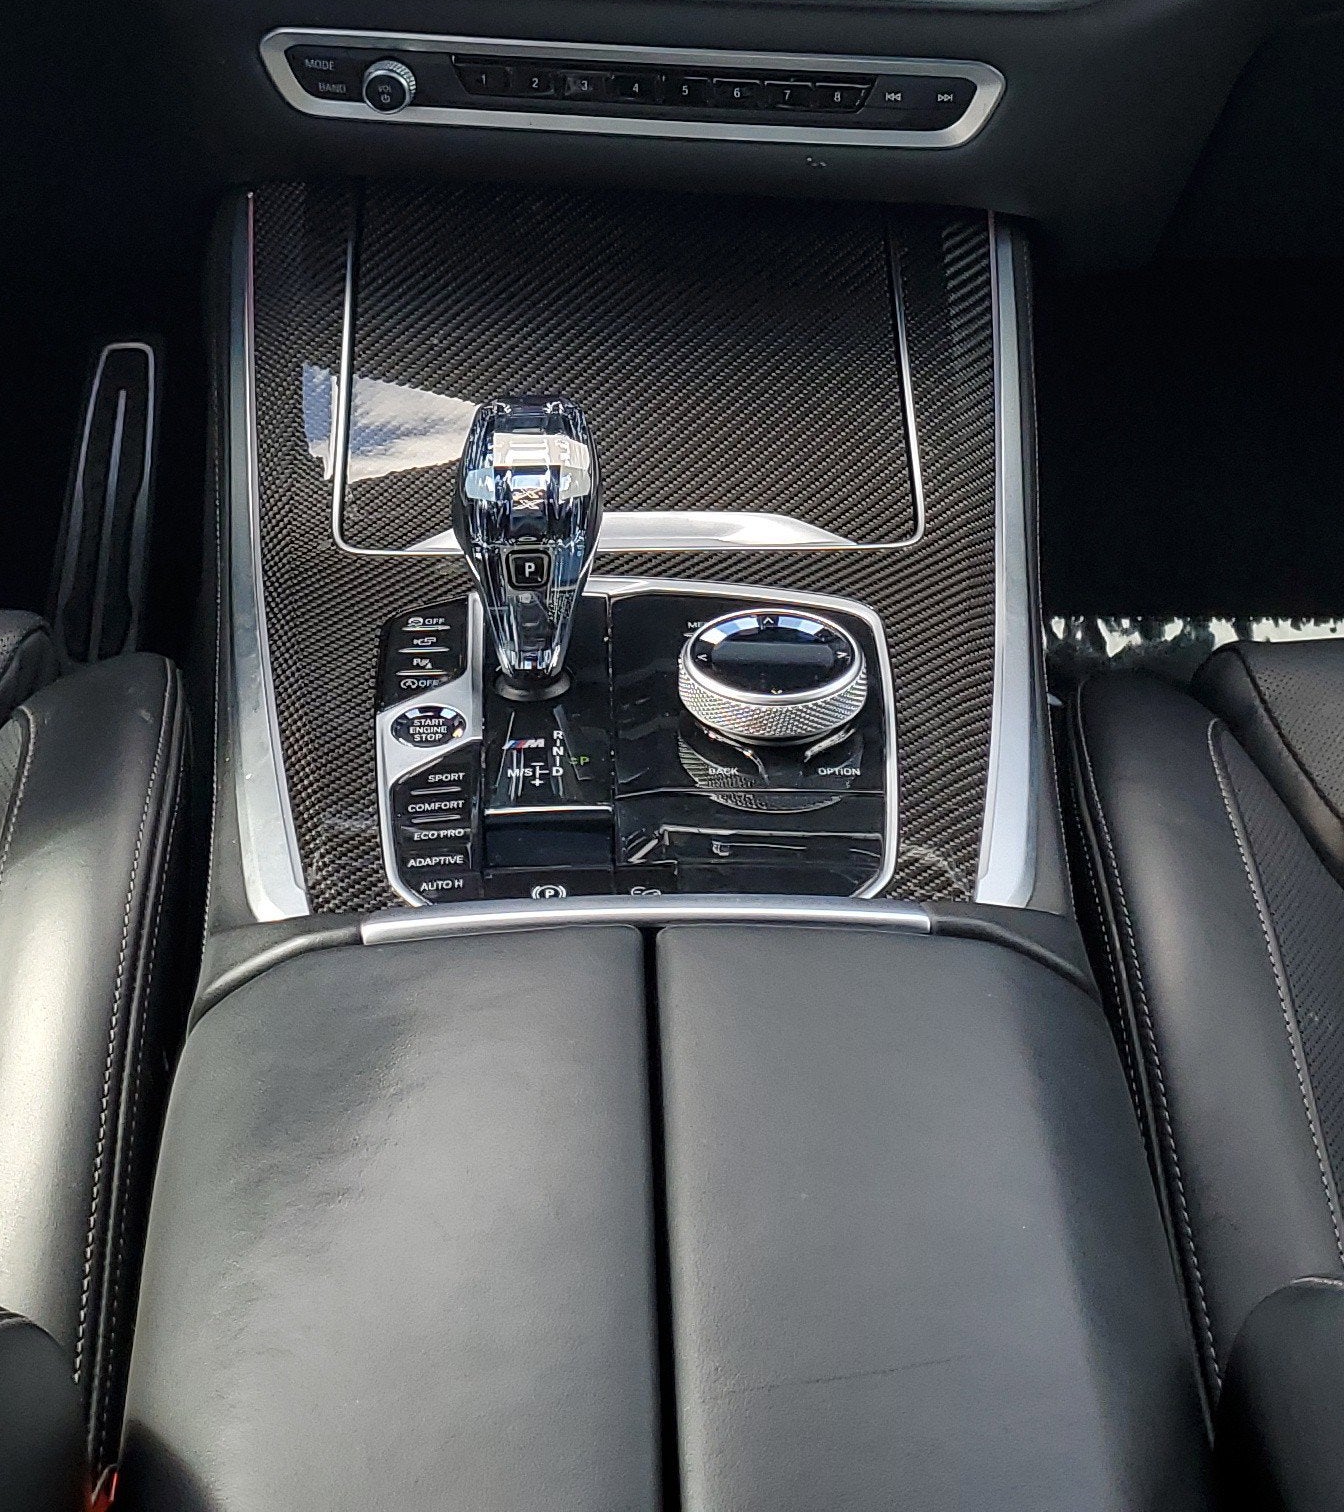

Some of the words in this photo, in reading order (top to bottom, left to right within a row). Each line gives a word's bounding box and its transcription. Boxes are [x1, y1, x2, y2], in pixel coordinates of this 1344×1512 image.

[305, 58, 335, 71] MODE
[481, 73, 487, 86] 1
[532, 77, 539, 89] 2
[581, 80, 588, 91] 3
[318, 81, 347, 94] BAND
[377, 84, 392, 93] VOL
[632, 82, 639, 94] 4
[682, 83, 689, 96] 5
[733, 86, 741, 99] 6
[783, 89, 791, 102] 7
[834, 91, 841, 103] 8
[524, 561, 536, 578] P
[424, 617, 445, 625] OFF
[687, 621, 705, 629] ME
[418, 679, 439, 688] OFF
[413, 718, 445, 727] START
[409, 726, 447, 734] ENGINE
[413, 733, 443, 742] STOP
[427, 772, 465, 783] SPORT
[507, 768, 533, 778] M/S
[708, 767, 739, 776] BACK
[818, 767, 861, 776] OPTION
[407, 800, 465, 813] COMFORT
[413, 830, 438, 841] ECO
[440, 828, 465, 839] PRO
[407, 855, 464, 868] ADAPTIVE
[420, 880, 452, 892] AUTO
[454, 879, 463, 888] H
[545, 889, 555, 899] P
